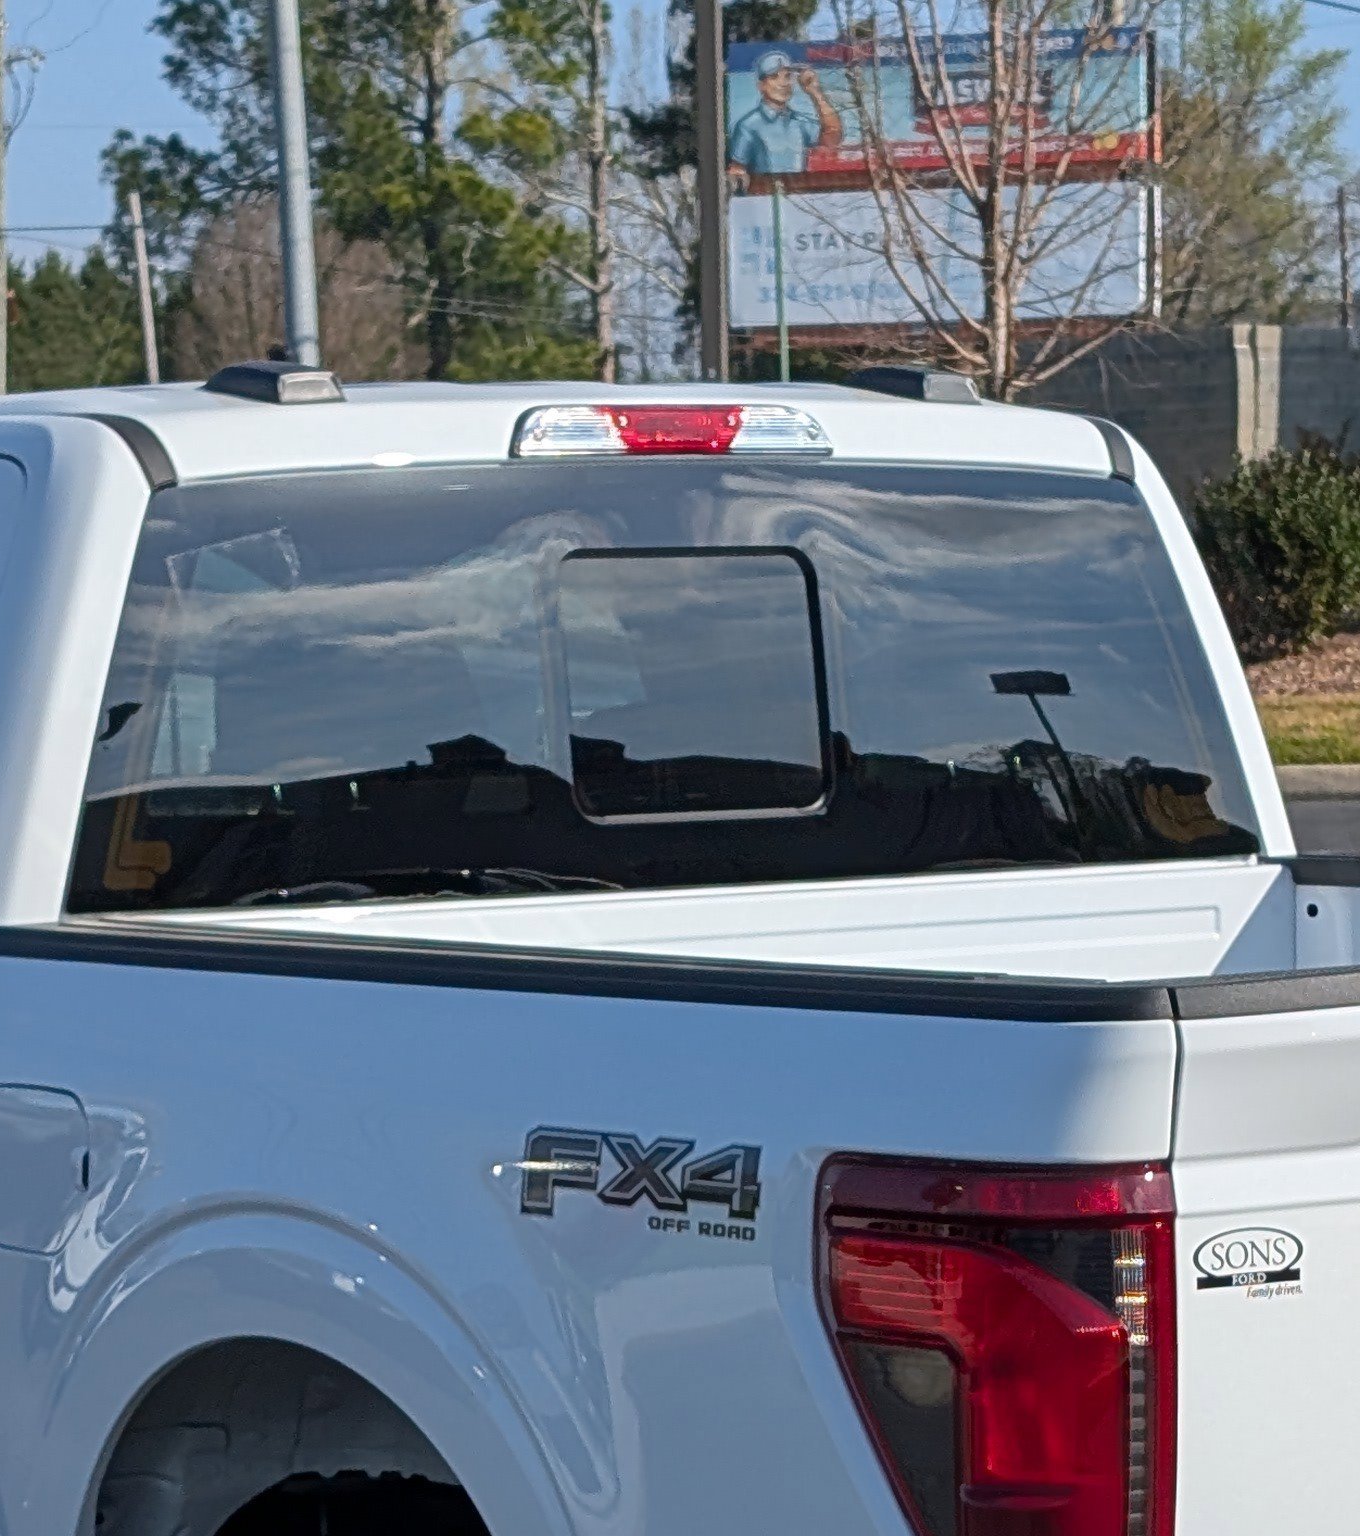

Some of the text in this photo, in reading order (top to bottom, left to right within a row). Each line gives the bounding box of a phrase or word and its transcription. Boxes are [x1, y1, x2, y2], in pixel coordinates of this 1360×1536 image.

[521, 1125, 763, 1221] FX4
[648, 1215, 756, 1241] OFF ROAD
[1210, 1237, 1286, 1271] SONS
[1232, 1272, 1267, 1286] FORD
